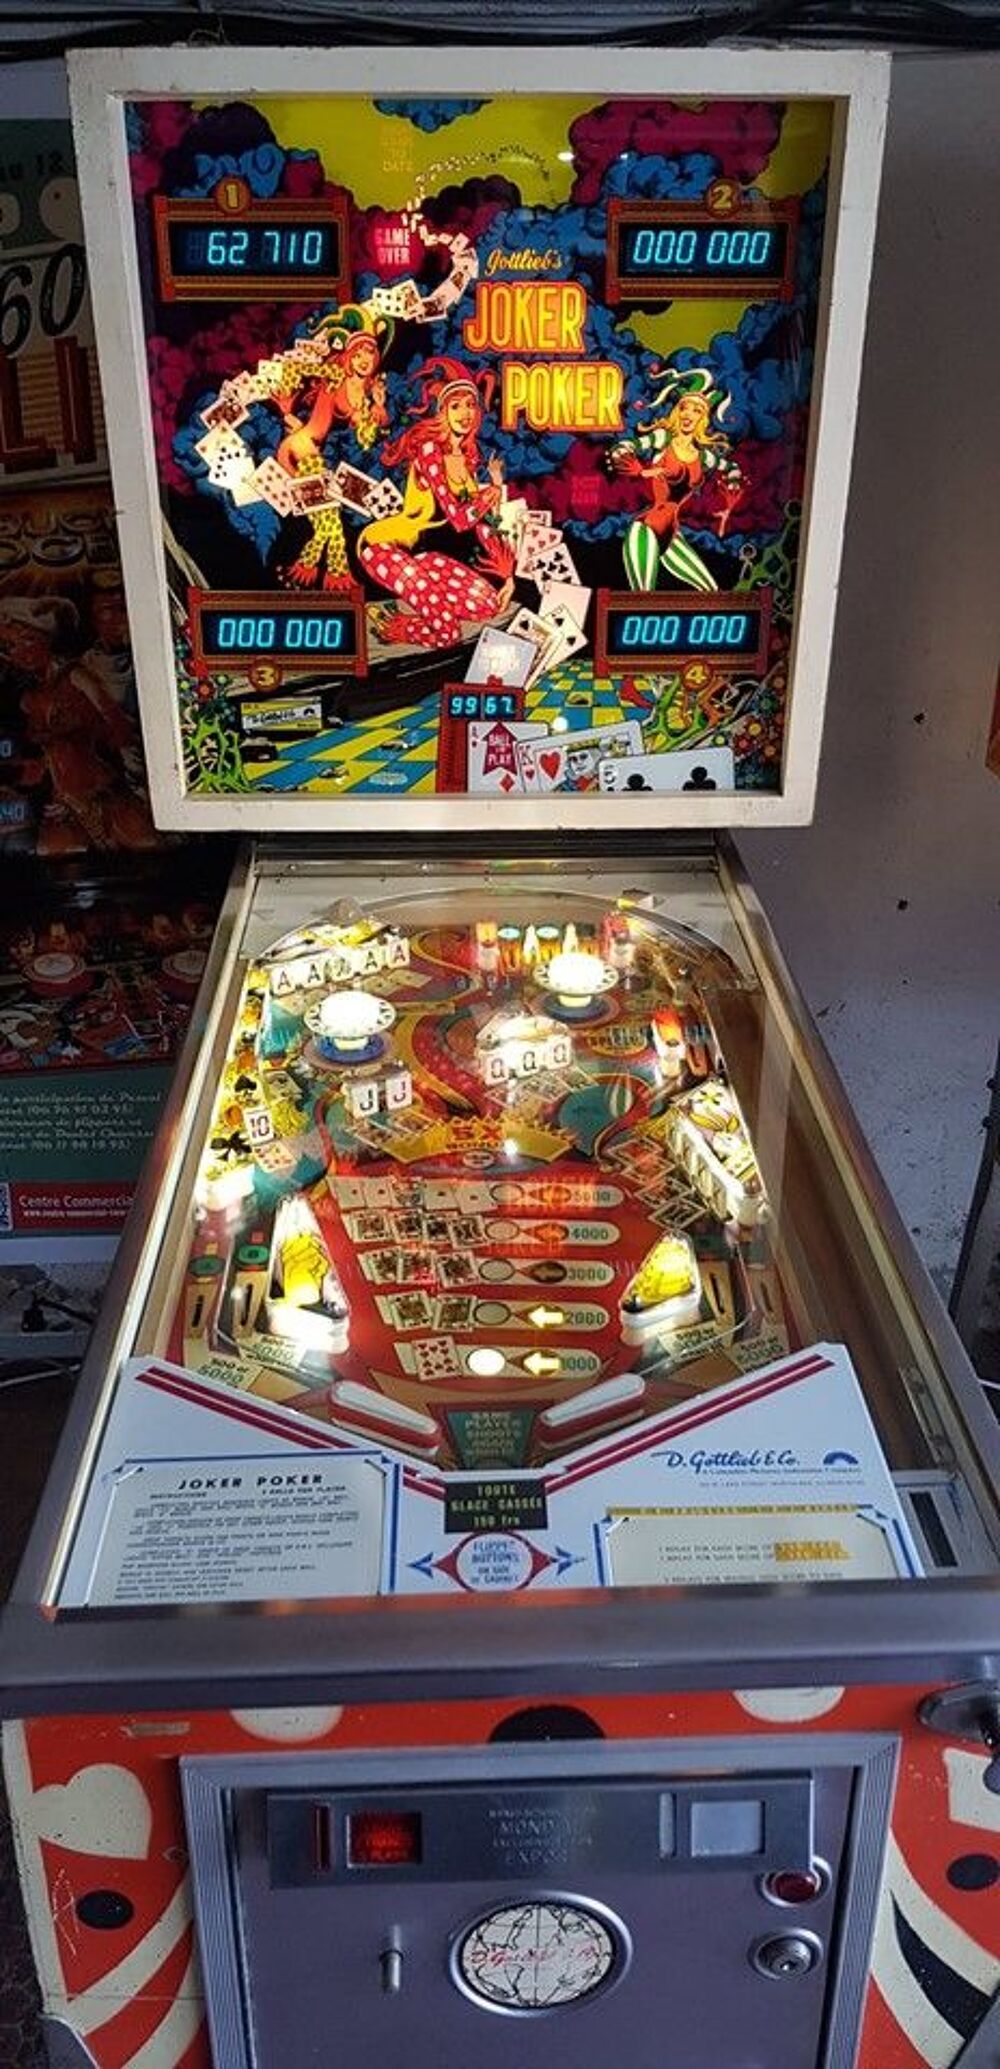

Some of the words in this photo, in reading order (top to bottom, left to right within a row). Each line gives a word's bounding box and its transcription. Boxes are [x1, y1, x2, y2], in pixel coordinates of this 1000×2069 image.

[225, 184, 238, 207] 1
[713, 186, 732, 208] 2
[207, 231, 248, 265] 62
[265, 231, 322, 265] 710
[375, 228, 410, 246] GAME
[633, 230, 697, 265] 000
[706, 230, 770, 265] 000
[377, 247, 410, 265] OVER
[486, 249, 563, 276] Gottlieb's
[464, 282, 587, 352] JOKER
[502, 361, 625, 432] POKER
[218, 618, 275, 648] 000
[285, 618, 342, 648] 000
[621, 615, 681, 645] 000
[687, 615, 747, 645] 000
[256, 667, 276, 685] 3
[688, 666, 707, 683] 4
[488, 733, 512, 747] BALL
[487, 753, 513, 767] PLAY
[359, 1088, 374, 1112] J
[393, 1080, 407, 1104] J
[250, 1114, 270, 1138] 10
[19, 1194, 61, 1209] Centre
[571, 1225, 610, 1241] 4000
[567, 1265, 607, 1281] 3000
[565, 1308, 606, 1326] 2000
[198, 1363, 245, 1383] 5000
[689, 1449, 761, 1475] Gottlieb
[777, 1449, 801, 1466] Co.
[178, 1477, 243, 1490] JOKER
[256, 1473, 323, 1487] POKER
